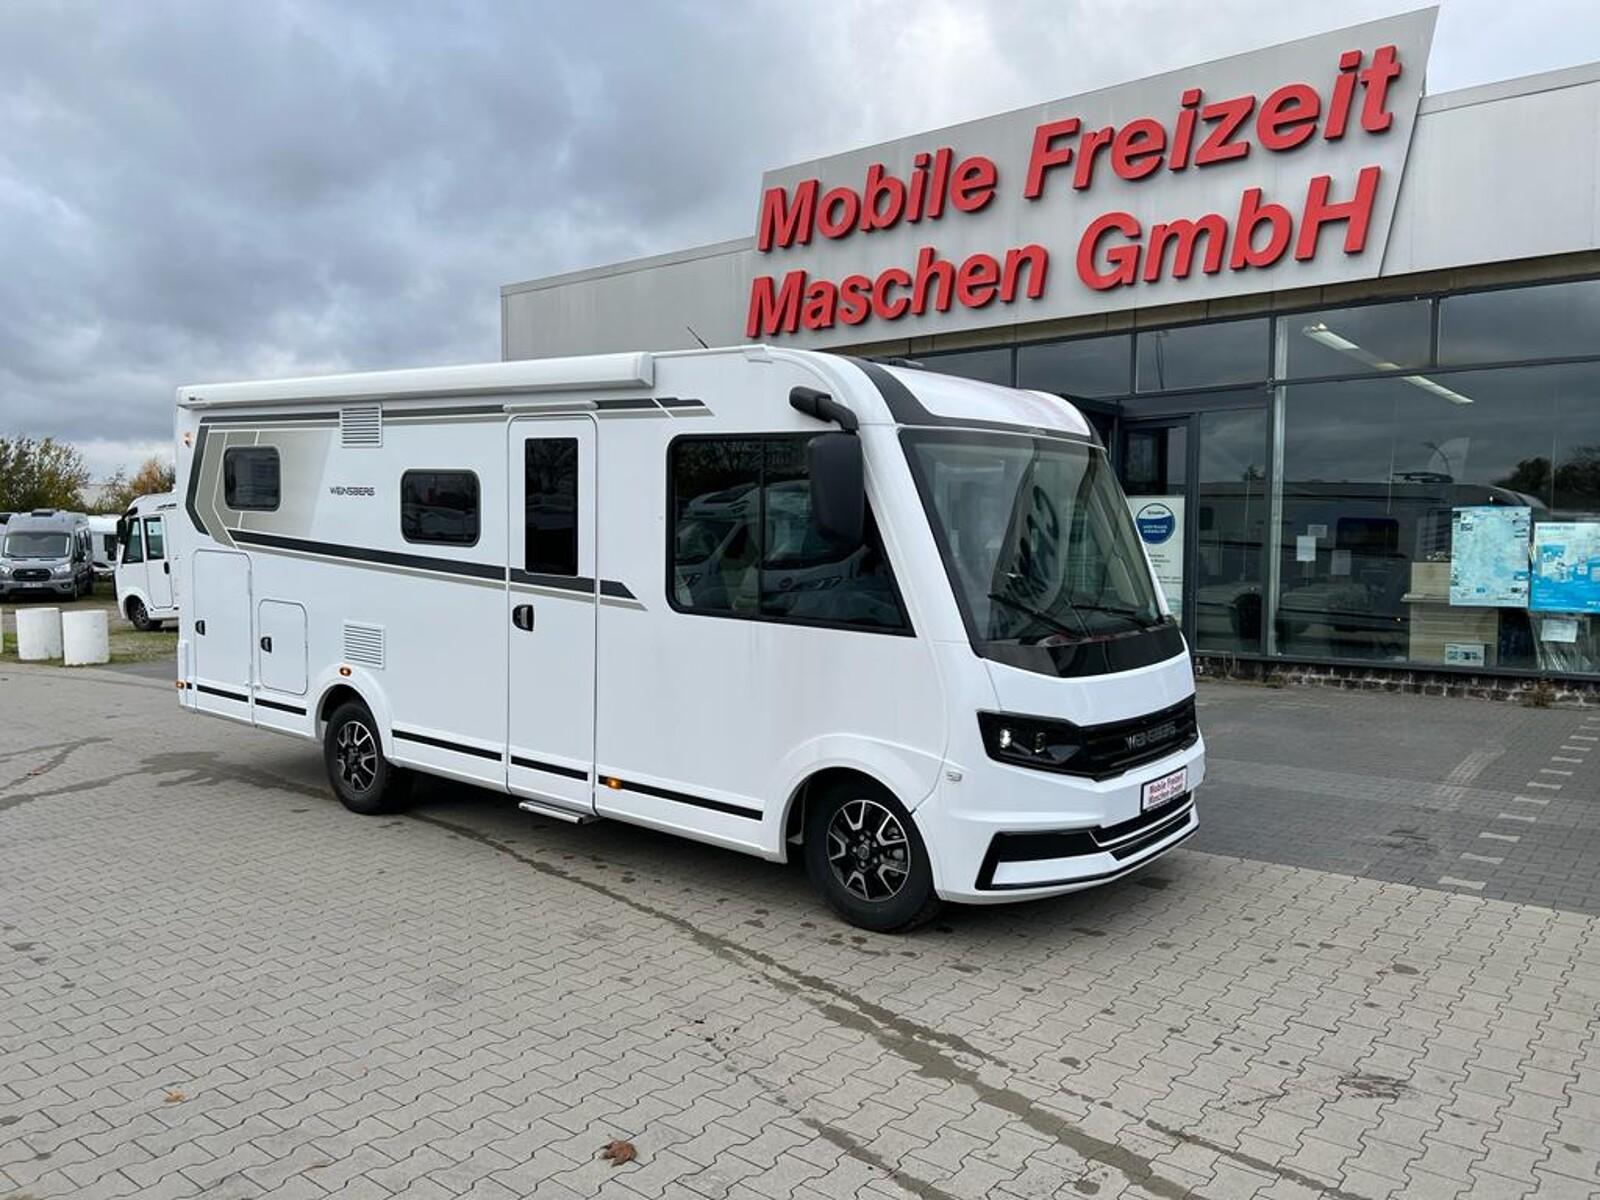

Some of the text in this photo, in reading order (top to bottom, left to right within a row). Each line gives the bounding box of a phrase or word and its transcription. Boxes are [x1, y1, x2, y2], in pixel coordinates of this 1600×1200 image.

[757, 45, 1401, 252] Mobile Freizeit
[745, 166, 1381, 338] Maschen GmbH
